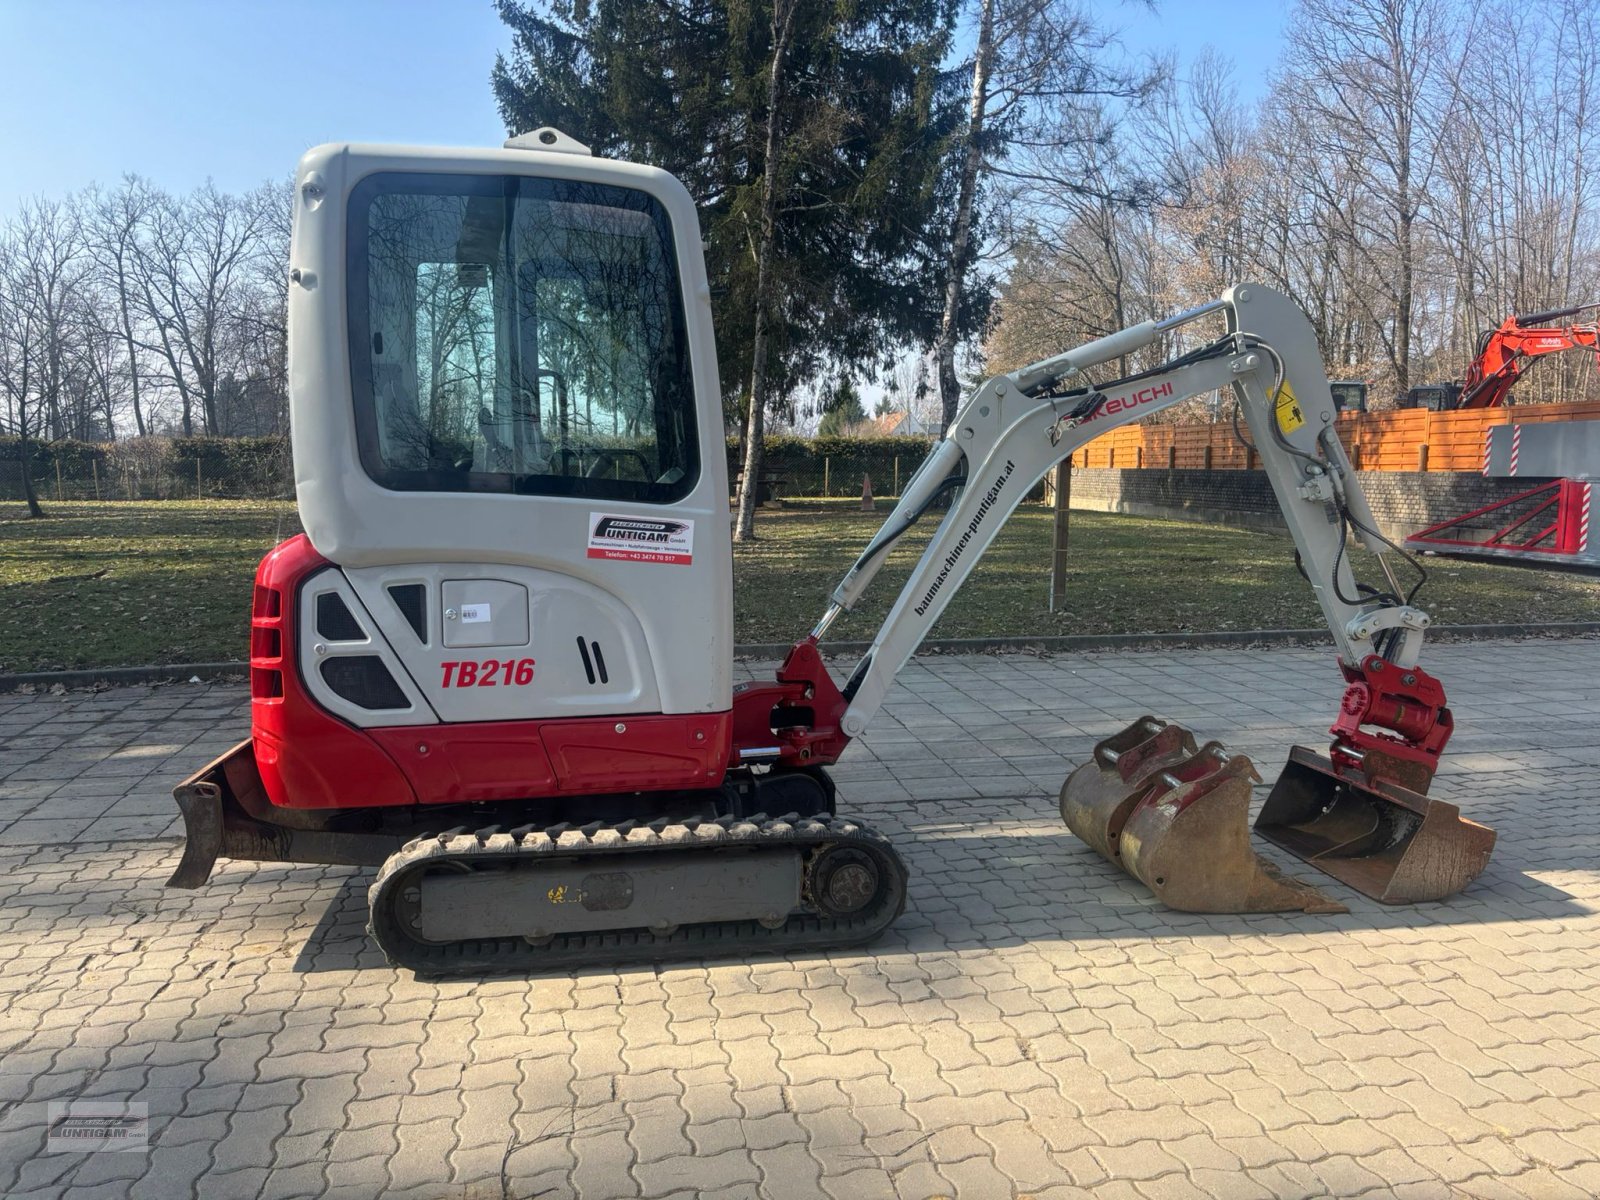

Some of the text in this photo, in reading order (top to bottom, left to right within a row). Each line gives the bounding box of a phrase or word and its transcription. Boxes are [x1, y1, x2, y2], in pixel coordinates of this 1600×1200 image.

[914, 459, 1016, 617] baumaschinen-puntigam.at
[605, 551, 628, 559] Telefon:
[440, 658, 536, 689] TB216
